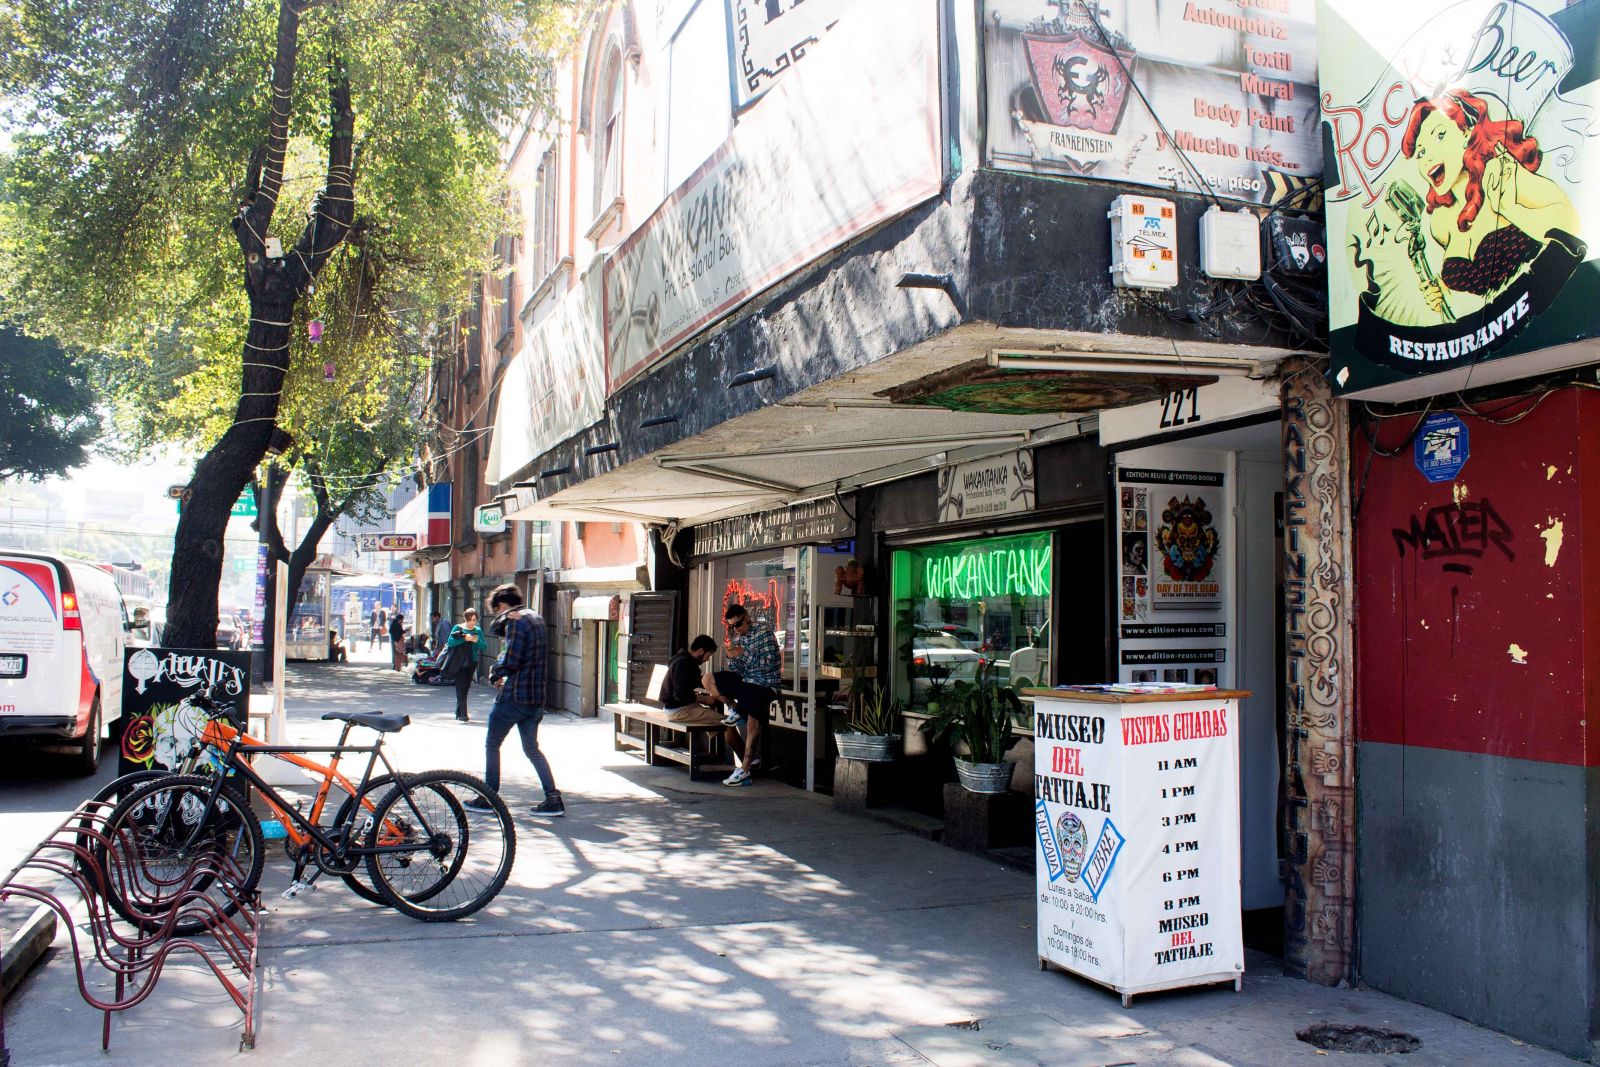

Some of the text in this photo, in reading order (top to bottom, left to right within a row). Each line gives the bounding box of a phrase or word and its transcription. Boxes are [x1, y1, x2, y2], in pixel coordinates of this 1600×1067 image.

[1183, 2, 1287, 40] Automotriz
[1243, 42, 1292, 71] Textil
[1447, 2, 1557, 91] Beer
[1240, 72, 1294, 101] Mural
[1194, 98, 1295, 133] Body Paint
[1050, 131, 1112, 153] FRANKEINSTEIN
[1156, 130, 1300, 169] y Mucho más...
[1228, 174, 1261, 193] piso
[1138, 229, 1166, 238] TELMEX
[1162, 250, 1173, 259] A2
[665, 244, 716, 303] Proessional
[1389, 291, 1530, 361] RESTAURANTE
[1159, 385, 1201, 429] 221
[963, 465, 1008, 491] WAKANTANKA
[1126, 471, 1149, 479] EDITION
[363, 536, 413, 549] 24 extra
[926, 545, 1051, 600] WAKANTANK
[1157, 584, 1219, 593] DAY OF THE DEAD
[1126, 626, 1214, 635] www.edition-reuss.com
[1126, 652, 1214, 661] www.edition-reuss.com
[1036, 712, 1105, 744] MUSEO
[1121, 708, 1227, 746] VISITAS GUIADAS
[1052, 746, 1084, 777] DEL
[1157, 757, 1197, 771] 11 AM
[1034, 774, 1111, 813] TATUAJE
[1161, 786, 1195, 799] 1 PM
[1162, 813, 1197, 827] 3 PM
[1036, 809, 1059, 874] ENTRADA
[1162, 840, 1199, 854] 4 PM
[1087, 826, 1116, 889] LIBRE
[1163, 868, 1200, 883] 6 PM
[1068, 888, 1073, 898] a
[1164, 896, 1201, 911] 8 PM
[1041, 893, 1108, 923] de: 10:00 a 20:00 hrs.
[1158, 913, 1209, 934] MUSEO
[1053, 924, 1094, 948] Domingos de:
[1171, 931, 1195, 947] DEL
[1047, 937, 1101, 966] 10:00 a 18:00 hrs.
[1154, 942, 1213, 965] TATUAJE
